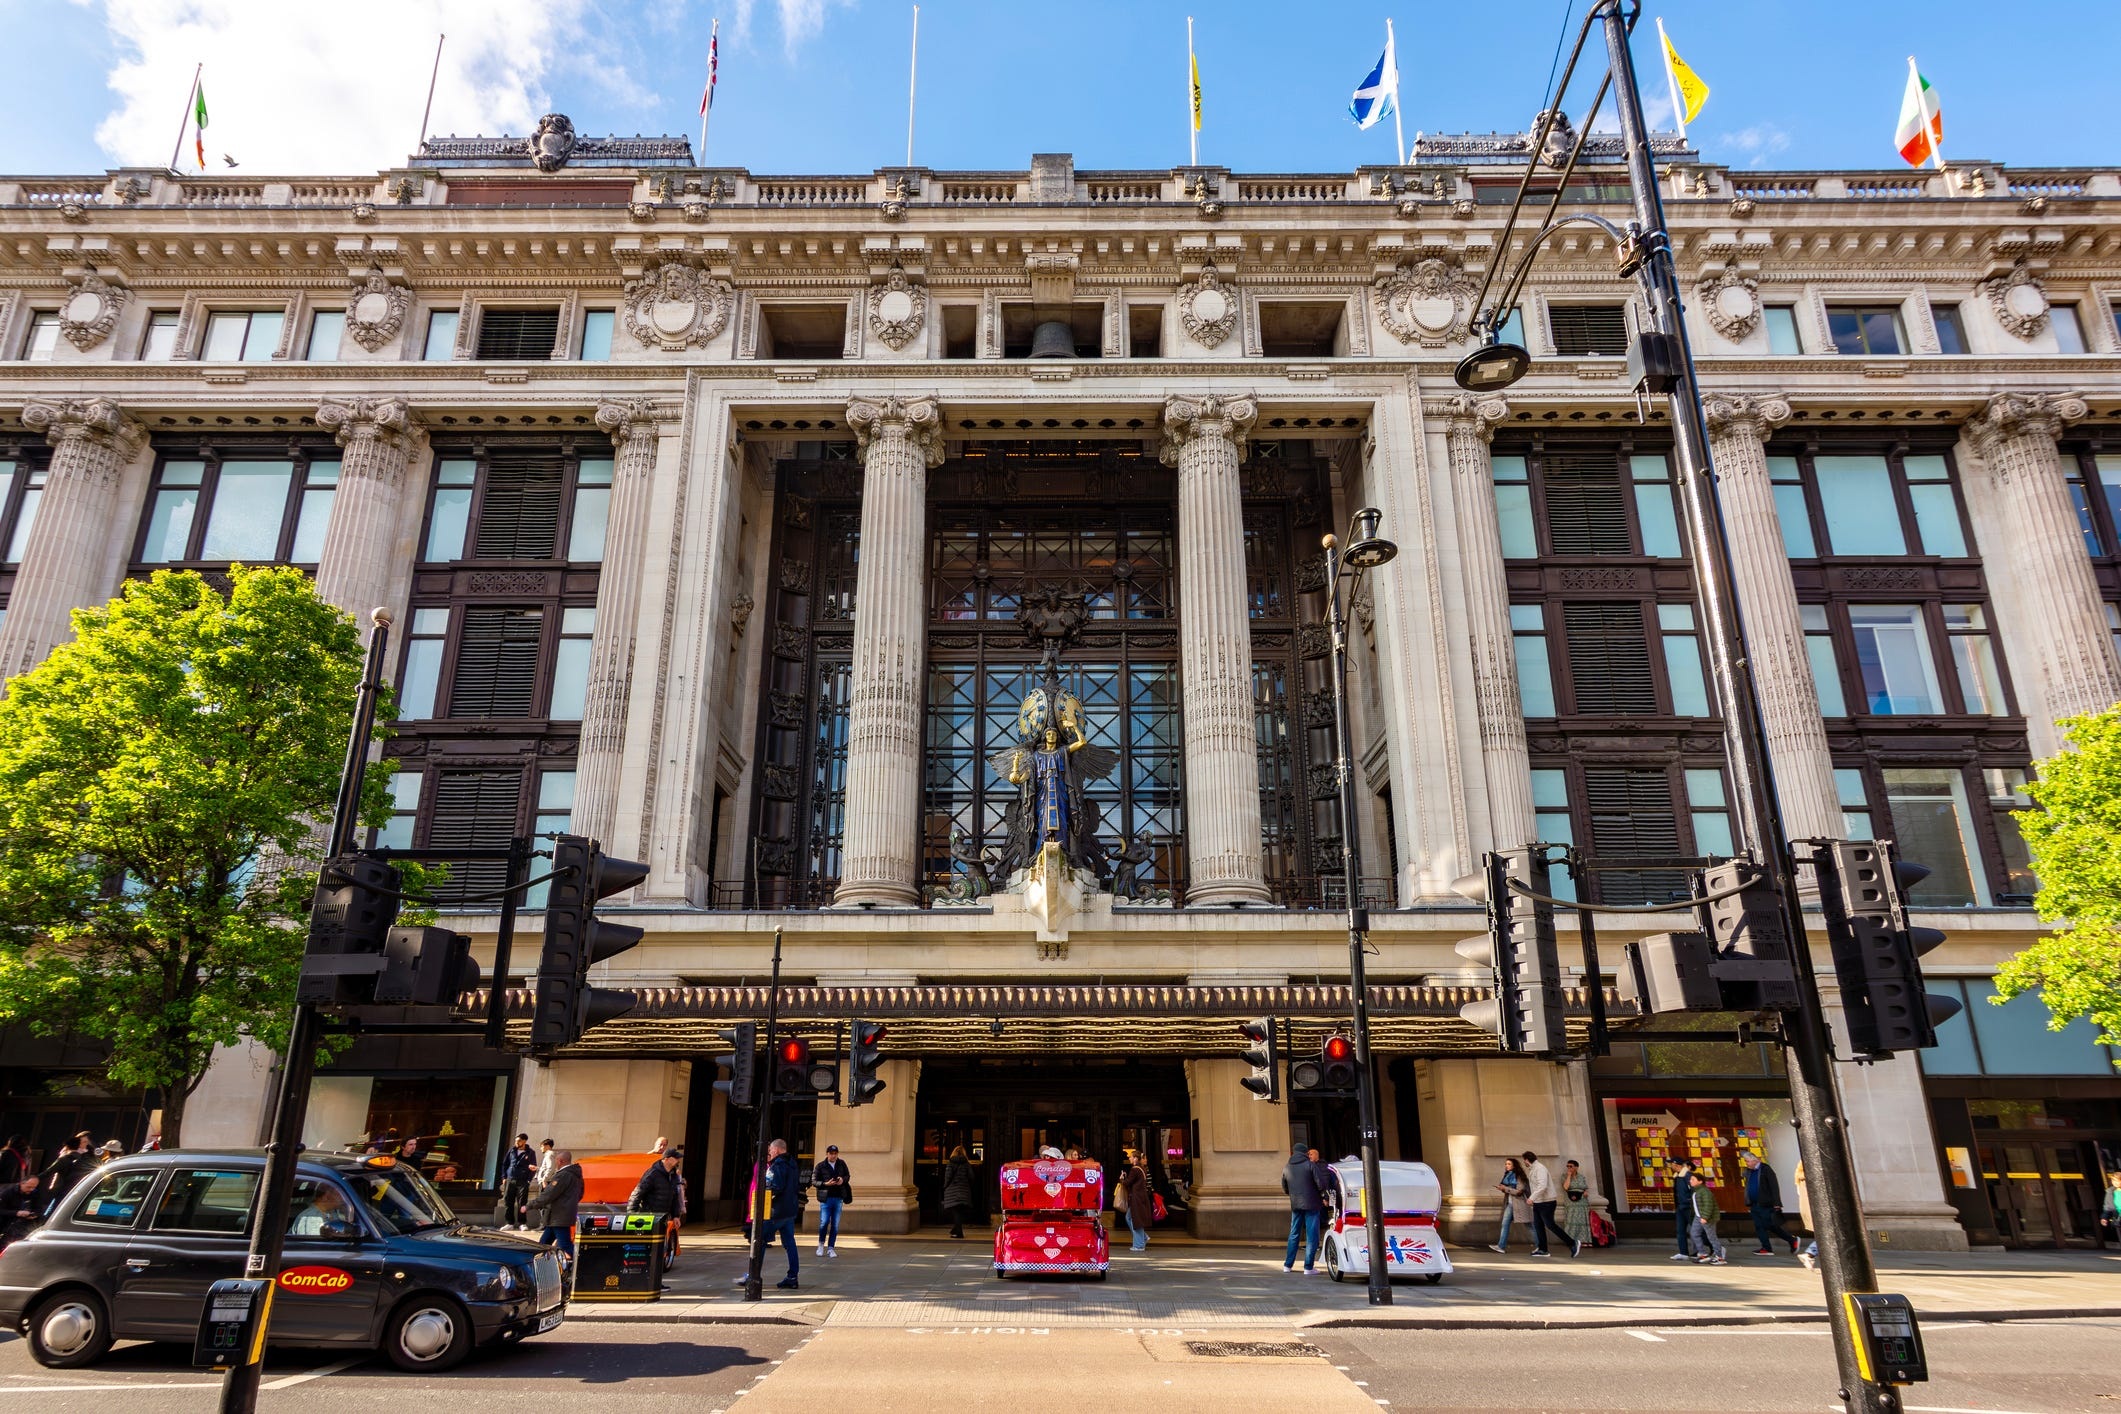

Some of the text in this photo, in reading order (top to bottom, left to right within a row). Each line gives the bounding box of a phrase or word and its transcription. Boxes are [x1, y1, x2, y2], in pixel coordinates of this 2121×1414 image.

[1035, 1165, 1071, 1173] London
[281, 1272, 348, 1287] ComCab
[944, 1327, 1208, 1336] LOOK RIGHT
